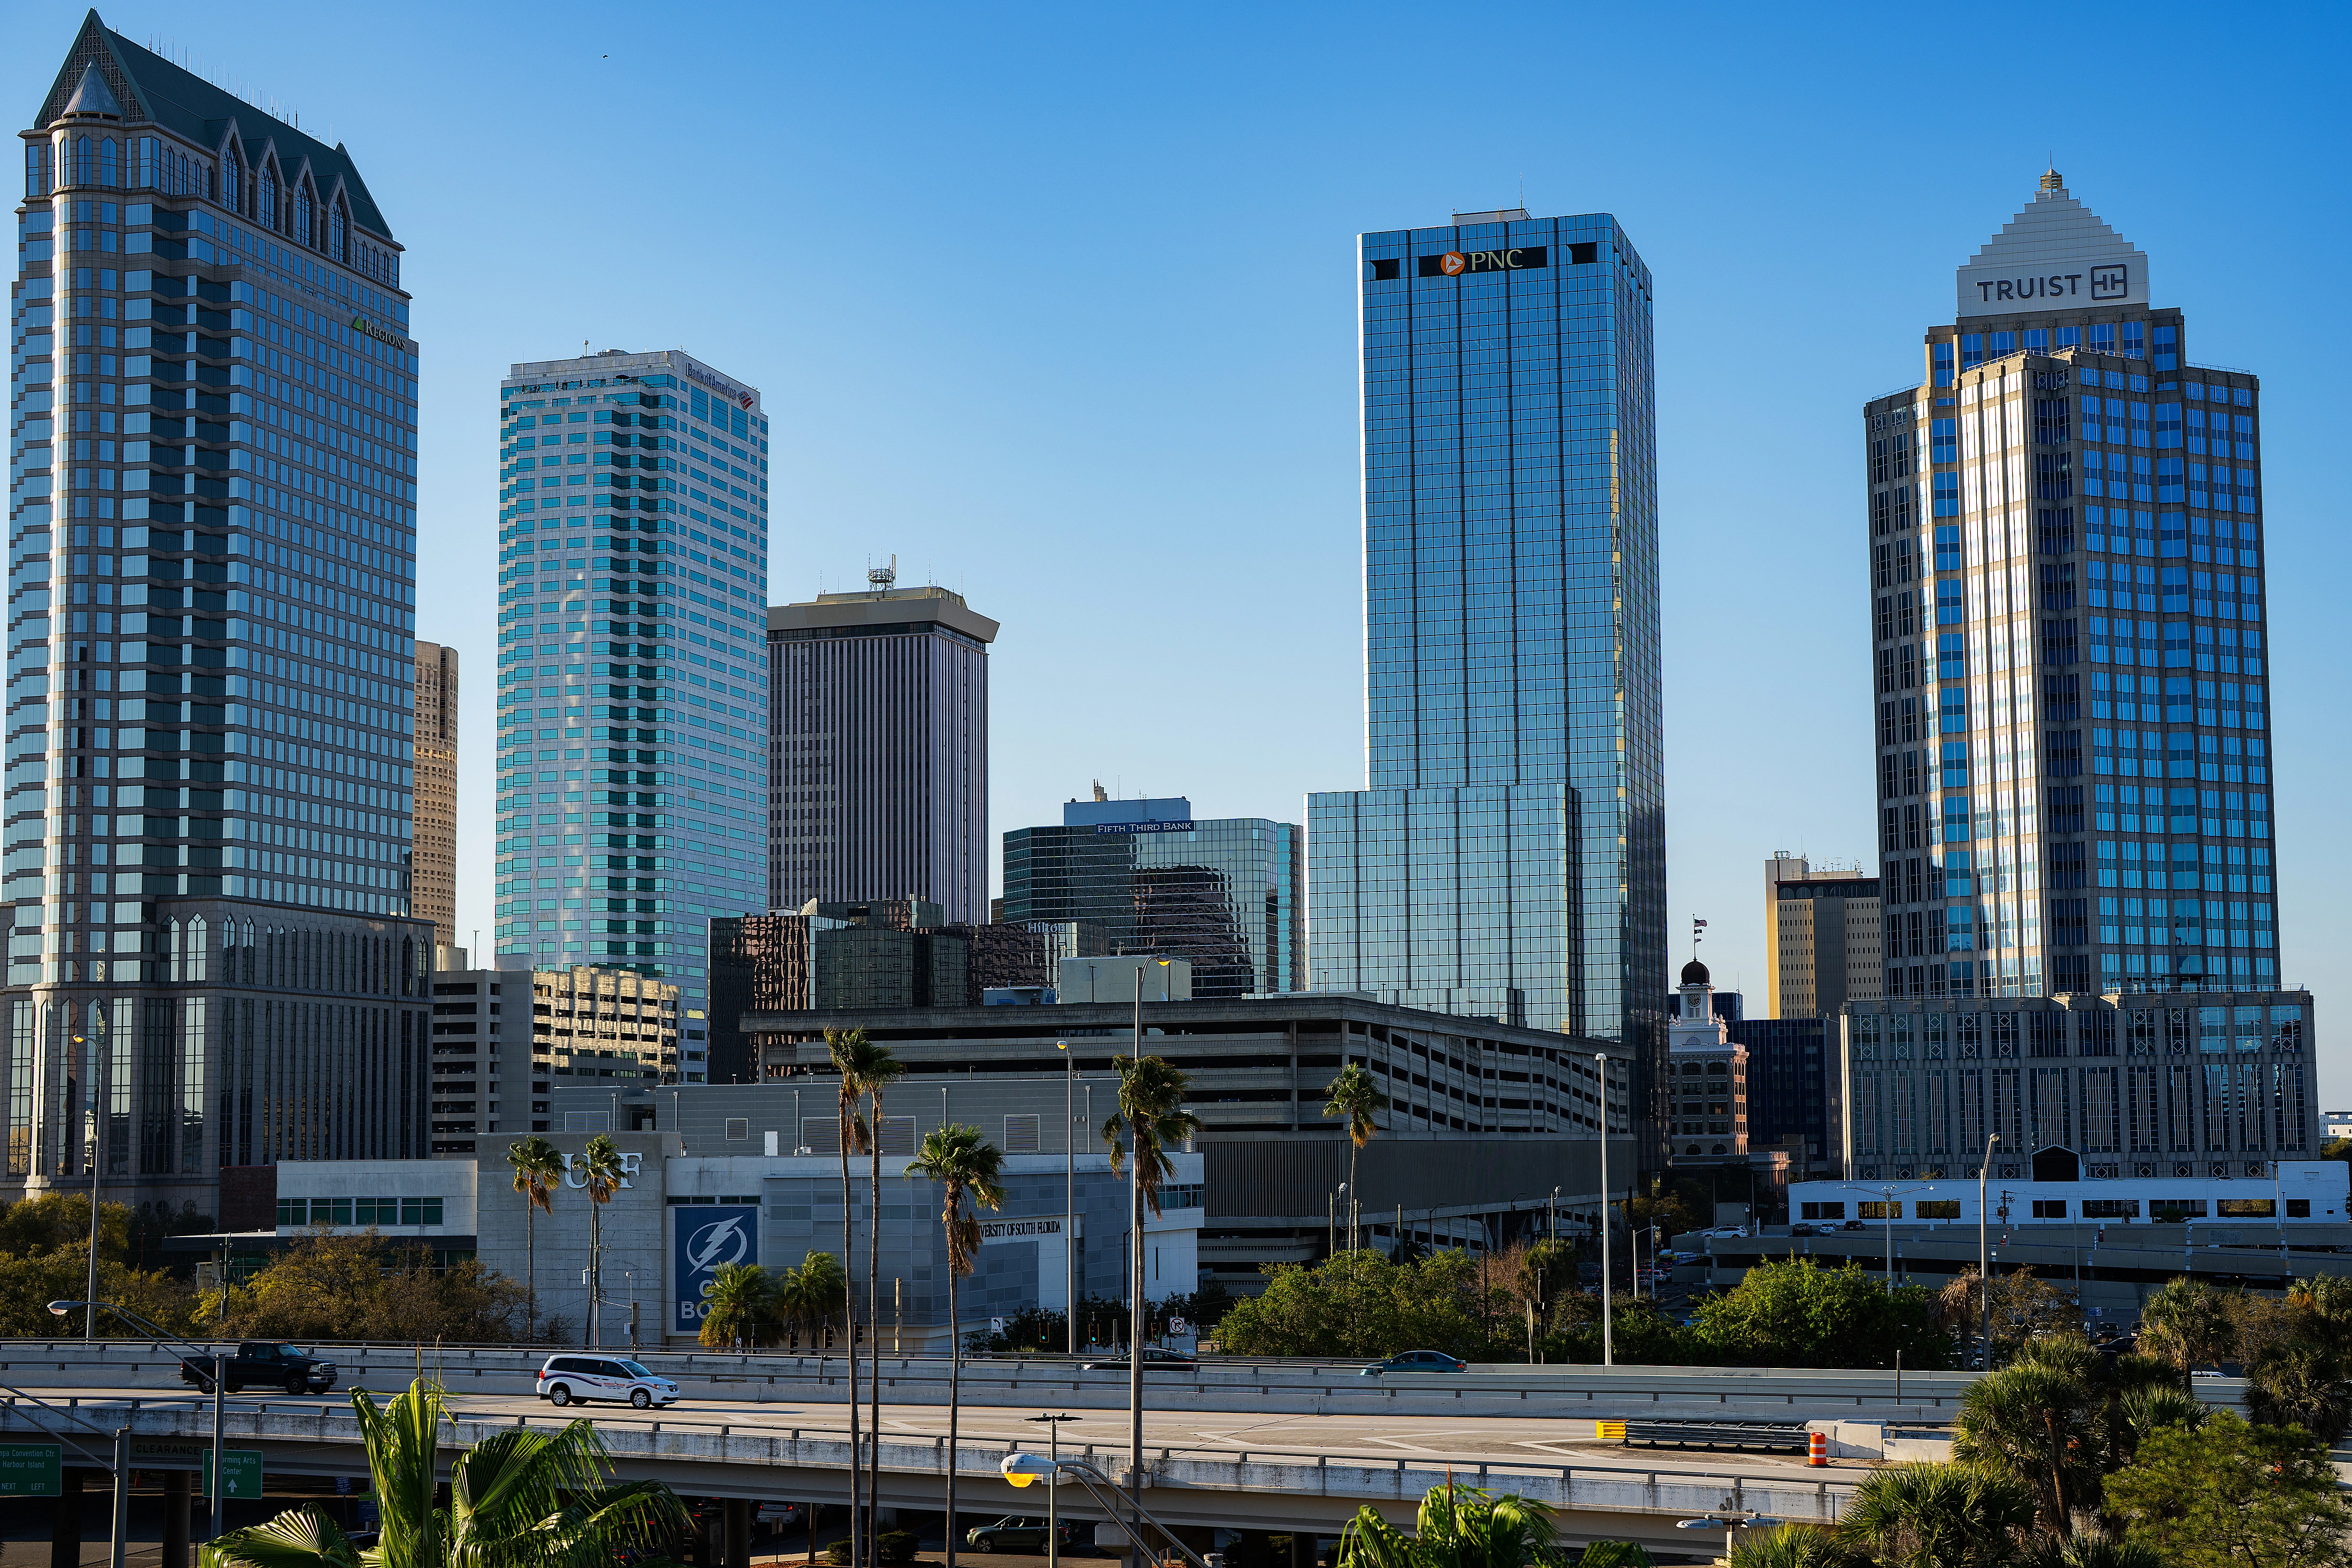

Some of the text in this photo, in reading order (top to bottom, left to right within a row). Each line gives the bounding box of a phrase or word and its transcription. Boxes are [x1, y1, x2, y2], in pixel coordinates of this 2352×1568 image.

[1468, 249, 1522, 271] PNC
[1976, 274, 2082, 302] TRUIST
[365, 320, 406, 350] REGIONS
[686, 362, 704, 384] Bank
[711, 375, 737, 400] America
[1097, 822, 1192, 833] FIFTH THIRD BANK
[1027, 921, 1066, 933] Hilton
[561, 1152, 643, 1189] UF
[1007, 1223, 1016, 1236] OF
[1016, 1222, 1036, 1236] SOUTH
[1037, 1220, 1061, 1234] FLORIDA
[136, 1444, 199, 1455] CLEARANCE
[3, 1460, 25, 1468] Harbour
[210, 1455, 241, 1465] Porming
[223, 1467, 242, 1475] Center
